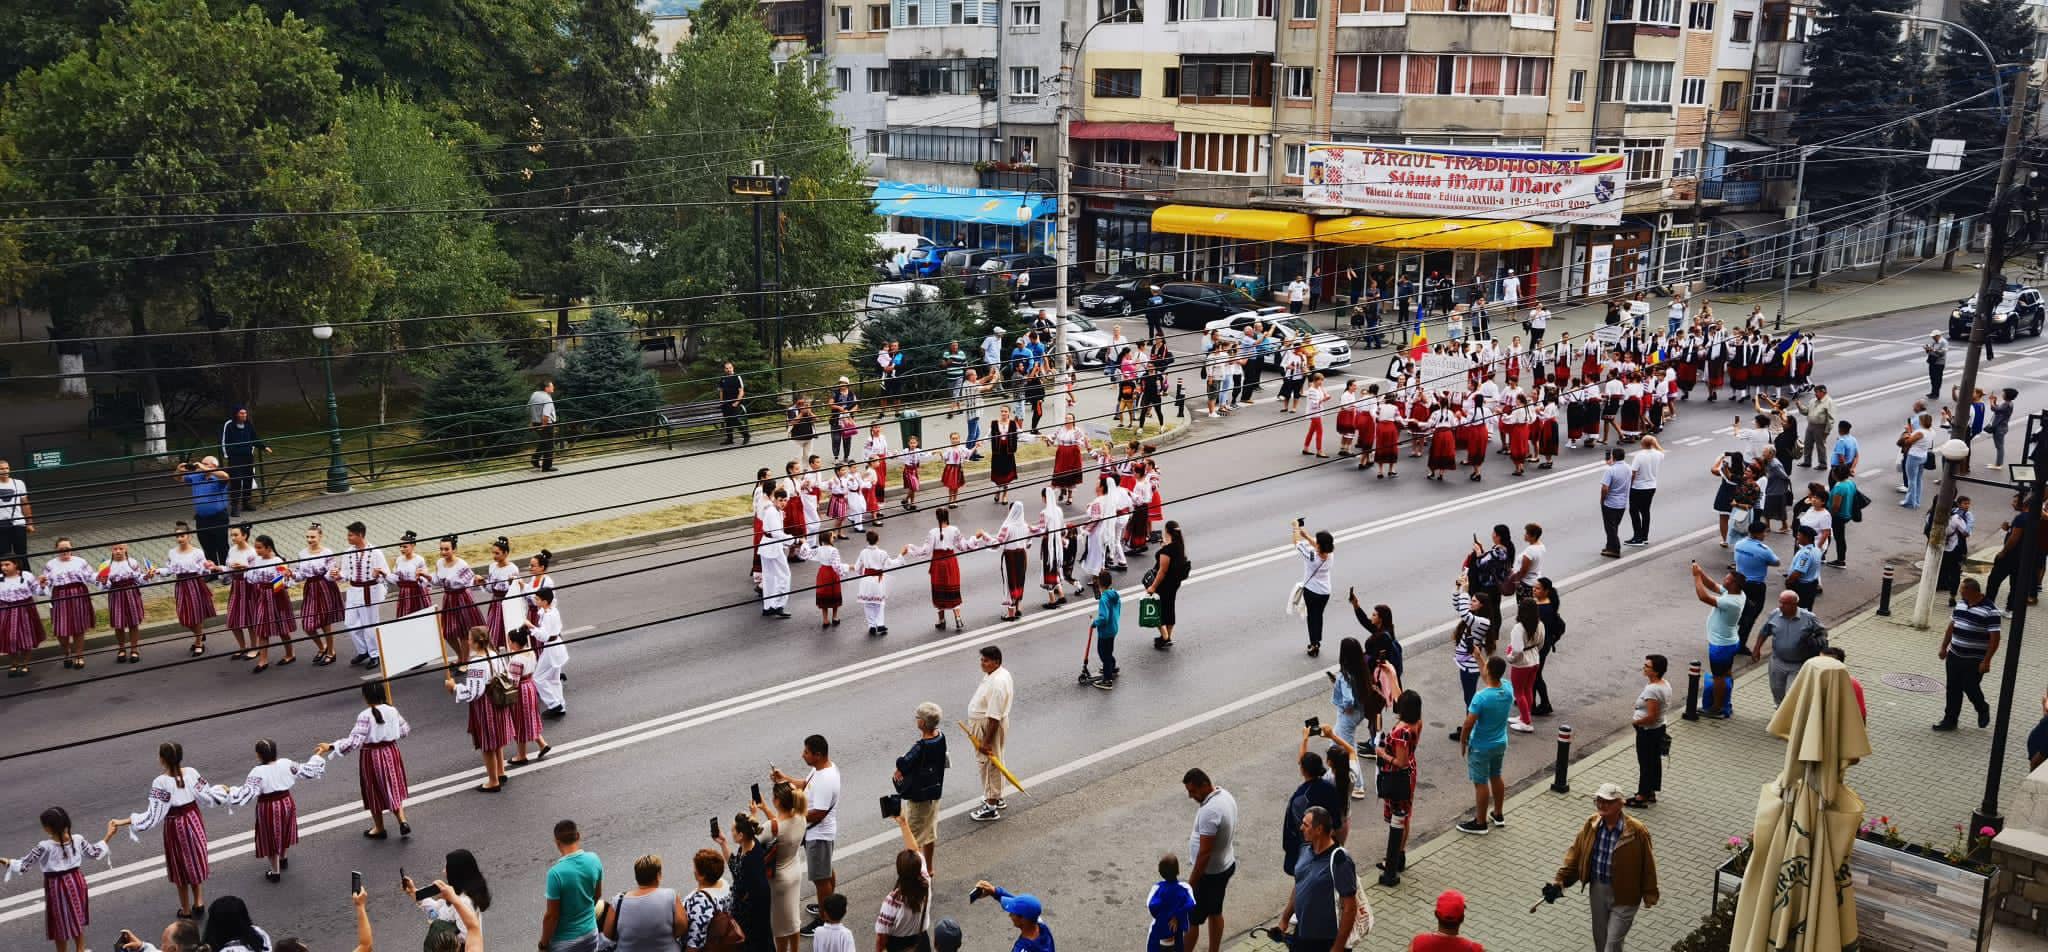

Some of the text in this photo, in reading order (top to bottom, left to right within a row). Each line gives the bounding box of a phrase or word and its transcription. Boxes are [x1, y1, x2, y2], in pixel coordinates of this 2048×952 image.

[1362, 148, 1435, 168] TÂRGUL
[1448, 173, 1505, 192] Maria
[1394, 189, 1404, 198] de
[1405, 190, 1431, 200] Munte
[1146, 604, 1156, 616] D
